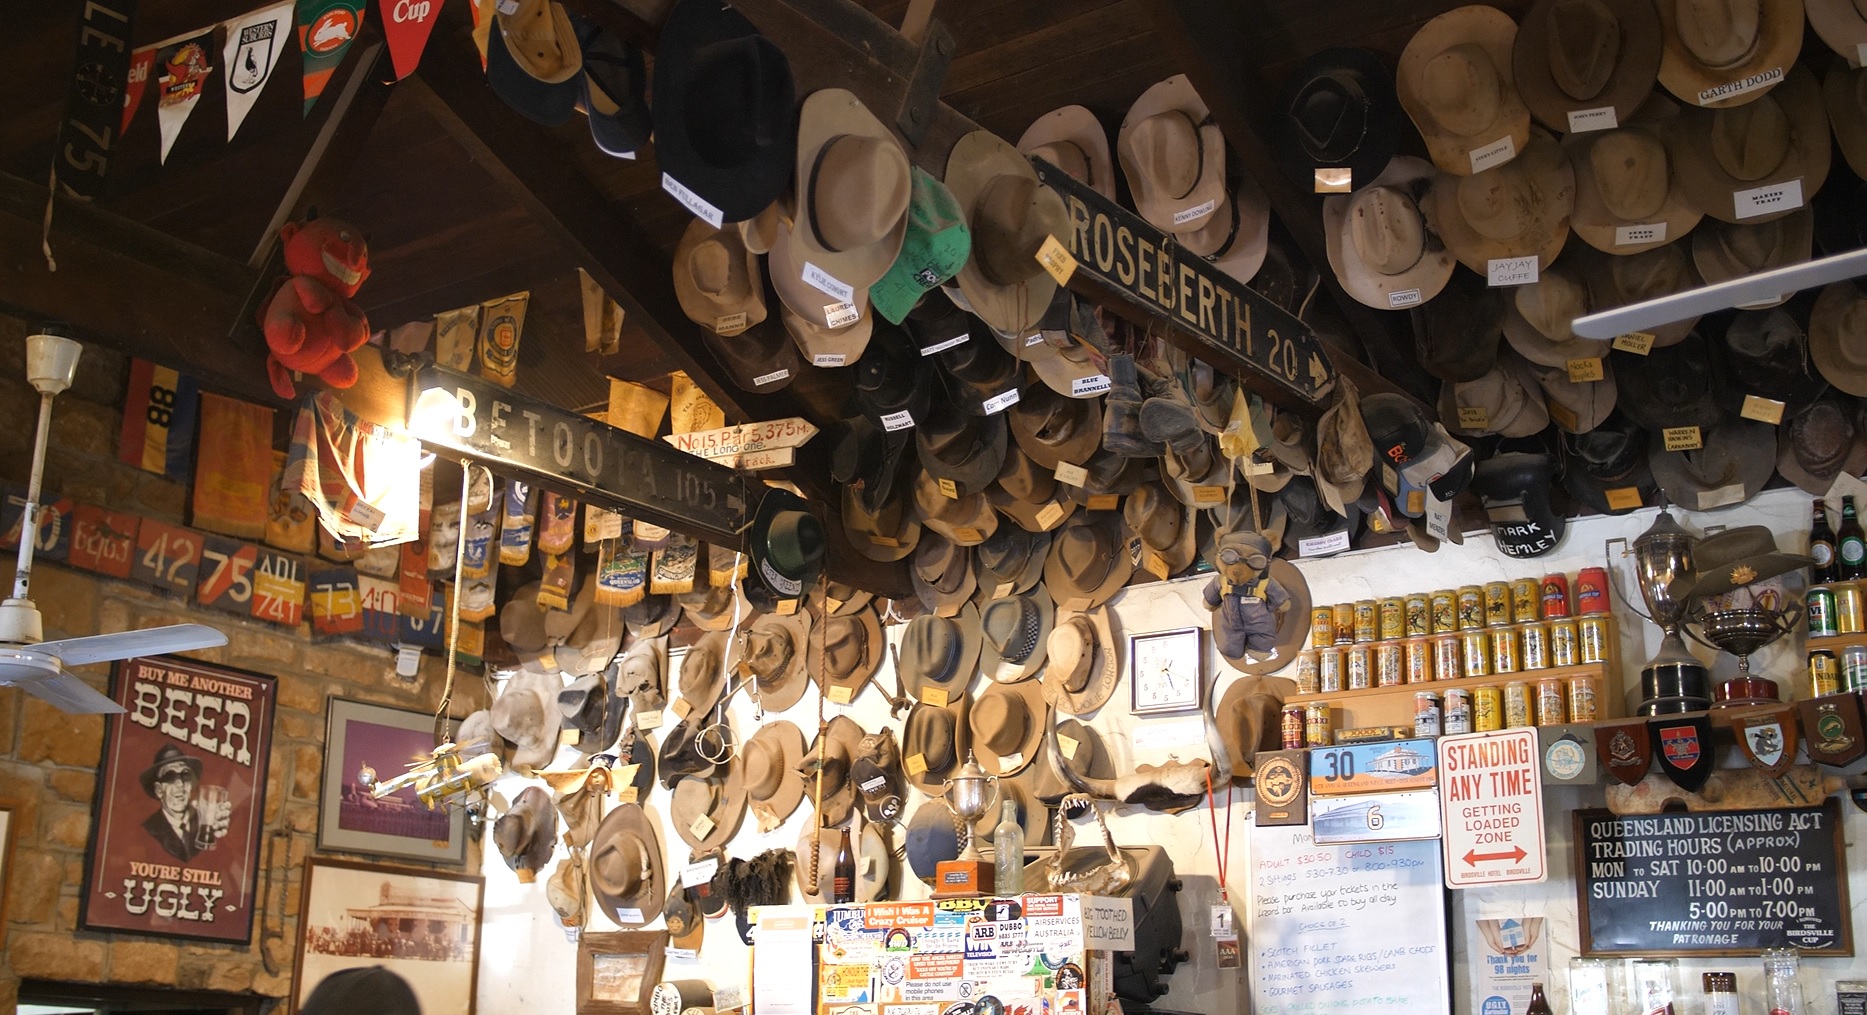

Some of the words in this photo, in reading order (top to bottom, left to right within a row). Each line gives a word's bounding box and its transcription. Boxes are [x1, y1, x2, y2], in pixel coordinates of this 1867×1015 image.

[393, 0, 430, 23] Cup
[241, 31, 274, 45] SUBURBS
[242, 22, 276, 38] WESTERN
[1700, 80, 1744, 101] GARTH
[1746, 67, 1782, 88] DODD
[1573, 112, 1588, 120] JOHN
[1588, 110, 1607, 119] PERRY
[64, 118, 111, 177] 75
[664, 177, 678, 193] BEN
[678, 189, 715, 221] FULLAGAR
[1175, 211, 1193, 223] KENNY
[1192, 203, 1213, 218] DOWLING
[1051, 246, 1068, 266] FRED
[810, 270, 827, 287] KYLIE
[1498, 271, 1531, 282] CUFFE
[1069, 195, 1253, 357] ROSEBERTH
[1267, 329, 1299, 382] 20
[1392, 292, 1418, 303] ROWDY
[826, 303, 854, 315] LAUREN
[830, 313, 857, 327] CHIMES
[956, 334, 970, 345] NUNN
[1621, 340, 1648, 353] MOLLER
[816, 355, 828, 363] JESS
[827, 355, 845, 363] GREEN
[754, 376, 768, 385] JESS
[767, 370, 789, 383] PALMER
[1081, 376, 1099, 385] BLUE
[1074, 382, 1112, 395] BRANNELLY
[147, 385, 177, 429] 88
[1001, 392, 1019, 405] Nunn
[682, 402, 694, 413] TEA
[721, 430, 749, 447] Par
[1668, 428, 1696, 438] WARREN
[453, 387, 658, 500] BETOOTA
[676, 469, 716, 510] 105
[744, 441, 767, 452] one.
[7, 495, 61, 551] 70
[1433, 511, 1446, 523] NAT
[1496, 521, 1542, 538] MARK
[1500, 531, 1556, 556] HEMLEY
[143, 532, 195, 587] 42
[203, 549, 253, 604] 75
[260, 554, 301, 587] ADL
[256, 591, 297, 626] 741
[316, 582, 356, 621] 73
[361, 586, 398, 636] 40
[137, 664, 166, 688] BUY
[166, 672, 190, 689] ME
[190, 677, 254, 700] ANOTHER
[130, 681, 252, 767] BEER
[1447, 736, 1530, 773] STANDING
[1324, 750, 1356, 783] 30
[1449, 773, 1486, 803] ANY
[1489, 768, 1533, 799] TIME
[1366, 805, 1385, 831] 6
[1462, 802, 1522, 819] GETTING
[1465, 816, 1521, 832] LOADED
[1590, 816, 1696, 839] QUEENSLAND
[1698, 813, 1783, 835] LICENSING
[1788, 812, 1824, 832] ACT
[1475, 832, 1513, 845] ZONE
[1591, 840, 1664, 860] TRADING
[1666, 837, 1722, 856] HOURS
[1727, 831, 1801, 854] (APPROX)
[1259, 858, 1290, 870] ADULT
[1345, 849, 1373, 860] CHILD
[1378, 845, 1395, 856] $15
[182, 867, 223, 886] STILL
[1460, 870, 1486, 879] BIRDSVILLE
[1487, 869, 1502, 878] HOTEL
[1506, 867, 1532, 877] BIRDSVILLE
[1591, 861, 1625, 879] MON
[1633, 867, 1645, 877] TO
[1650, 859, 1680, 877] SAT
[1686, 858, 1728, 876] 10-00
[1729, 865, 1746, 875] AM
[1805, 862, 1822, 872] PM
[1257, 893, 1281, 906] Please
[1283, 889, 1318, 905] purchase
[1320, 887, 1338, 904] your
[1340, 882, 1369, 896] tickets
[1371, 884, 1381, 892] in
[1382, 881, 1399, 891] the
[1592, 879, 1661, 899] SUNDAY
[1686, 878, 1727, 898] 11-00
[1729, 886, 1746, 896] AM
[1796, 885, 1814, 895] PM
[123, 879, 224, 922] UGLY
[1026, 896, 1059, 905] SUPPORT
[1301, 899, 1335, 913] Available
[1338, 899, 1349, 909] to
[1350, 897, 1368, 911] buy
[1369, 894, 1379, 904] all
[1380, 893, 1398, 907] day
[873, 906, 895, 917] Wish
[901, 906, 921, 916] Was
[1094, 907, 1128, 922] TOOTHED
[1688, 901, 1728, 919] 5-00
[1729, 908, 1747, 918] PM
[1748, 907, 1762, 918] TO
[1763, 900, 1798, 918] 7-00
[1798, 906, 1816, 918] PM
[868, 916, 895, 929] Crazy
[896, 915, 929, 926] Cruiser
[999, 922, 1023, 932] DUBBO
[1034, 916, 1080, 927] AIRSERVICES
[1649, 919, 1708, 932] THANKING
[1709, 919, 1730, 931] YOU
[1733, 919, 1756, 931] FOR
[1758, 919, 1784, 931] YOUR
[974, 927, 995, 939] ARB
[1034, 929, 1075, 938] AUSTRALIA
[1672, 932, 1739, 945] PATRONAGE
[1786, 929, 1835, 937] BIRDSVILLE
[1801, 936, 1820, 944] CUP
[1267, 946, 1299, 958] SCOTCH
[1303, 941, 1339, 954] FILLET
[1267, 957, 1311, 970] AMERICAN
[1486, 954, 1509, 966] Thank
[1511, 955, 1525, 966] you
[1527, 954, 1538, 963] for
[1268, 971, 1312, 983] MARINATED
[1315, 966, 1352, 979] CHICKEN
[1494, 964, 1505, 975] 98
[1506, 964, 1531, 976] nights
[924, 988, 944, 996] phones
[1268, 984, 1305, 997] GOURMET
[1308, 979, 1354, 993] SAUSAGES
[1485, 1001, 1508, 1010] UGLY
